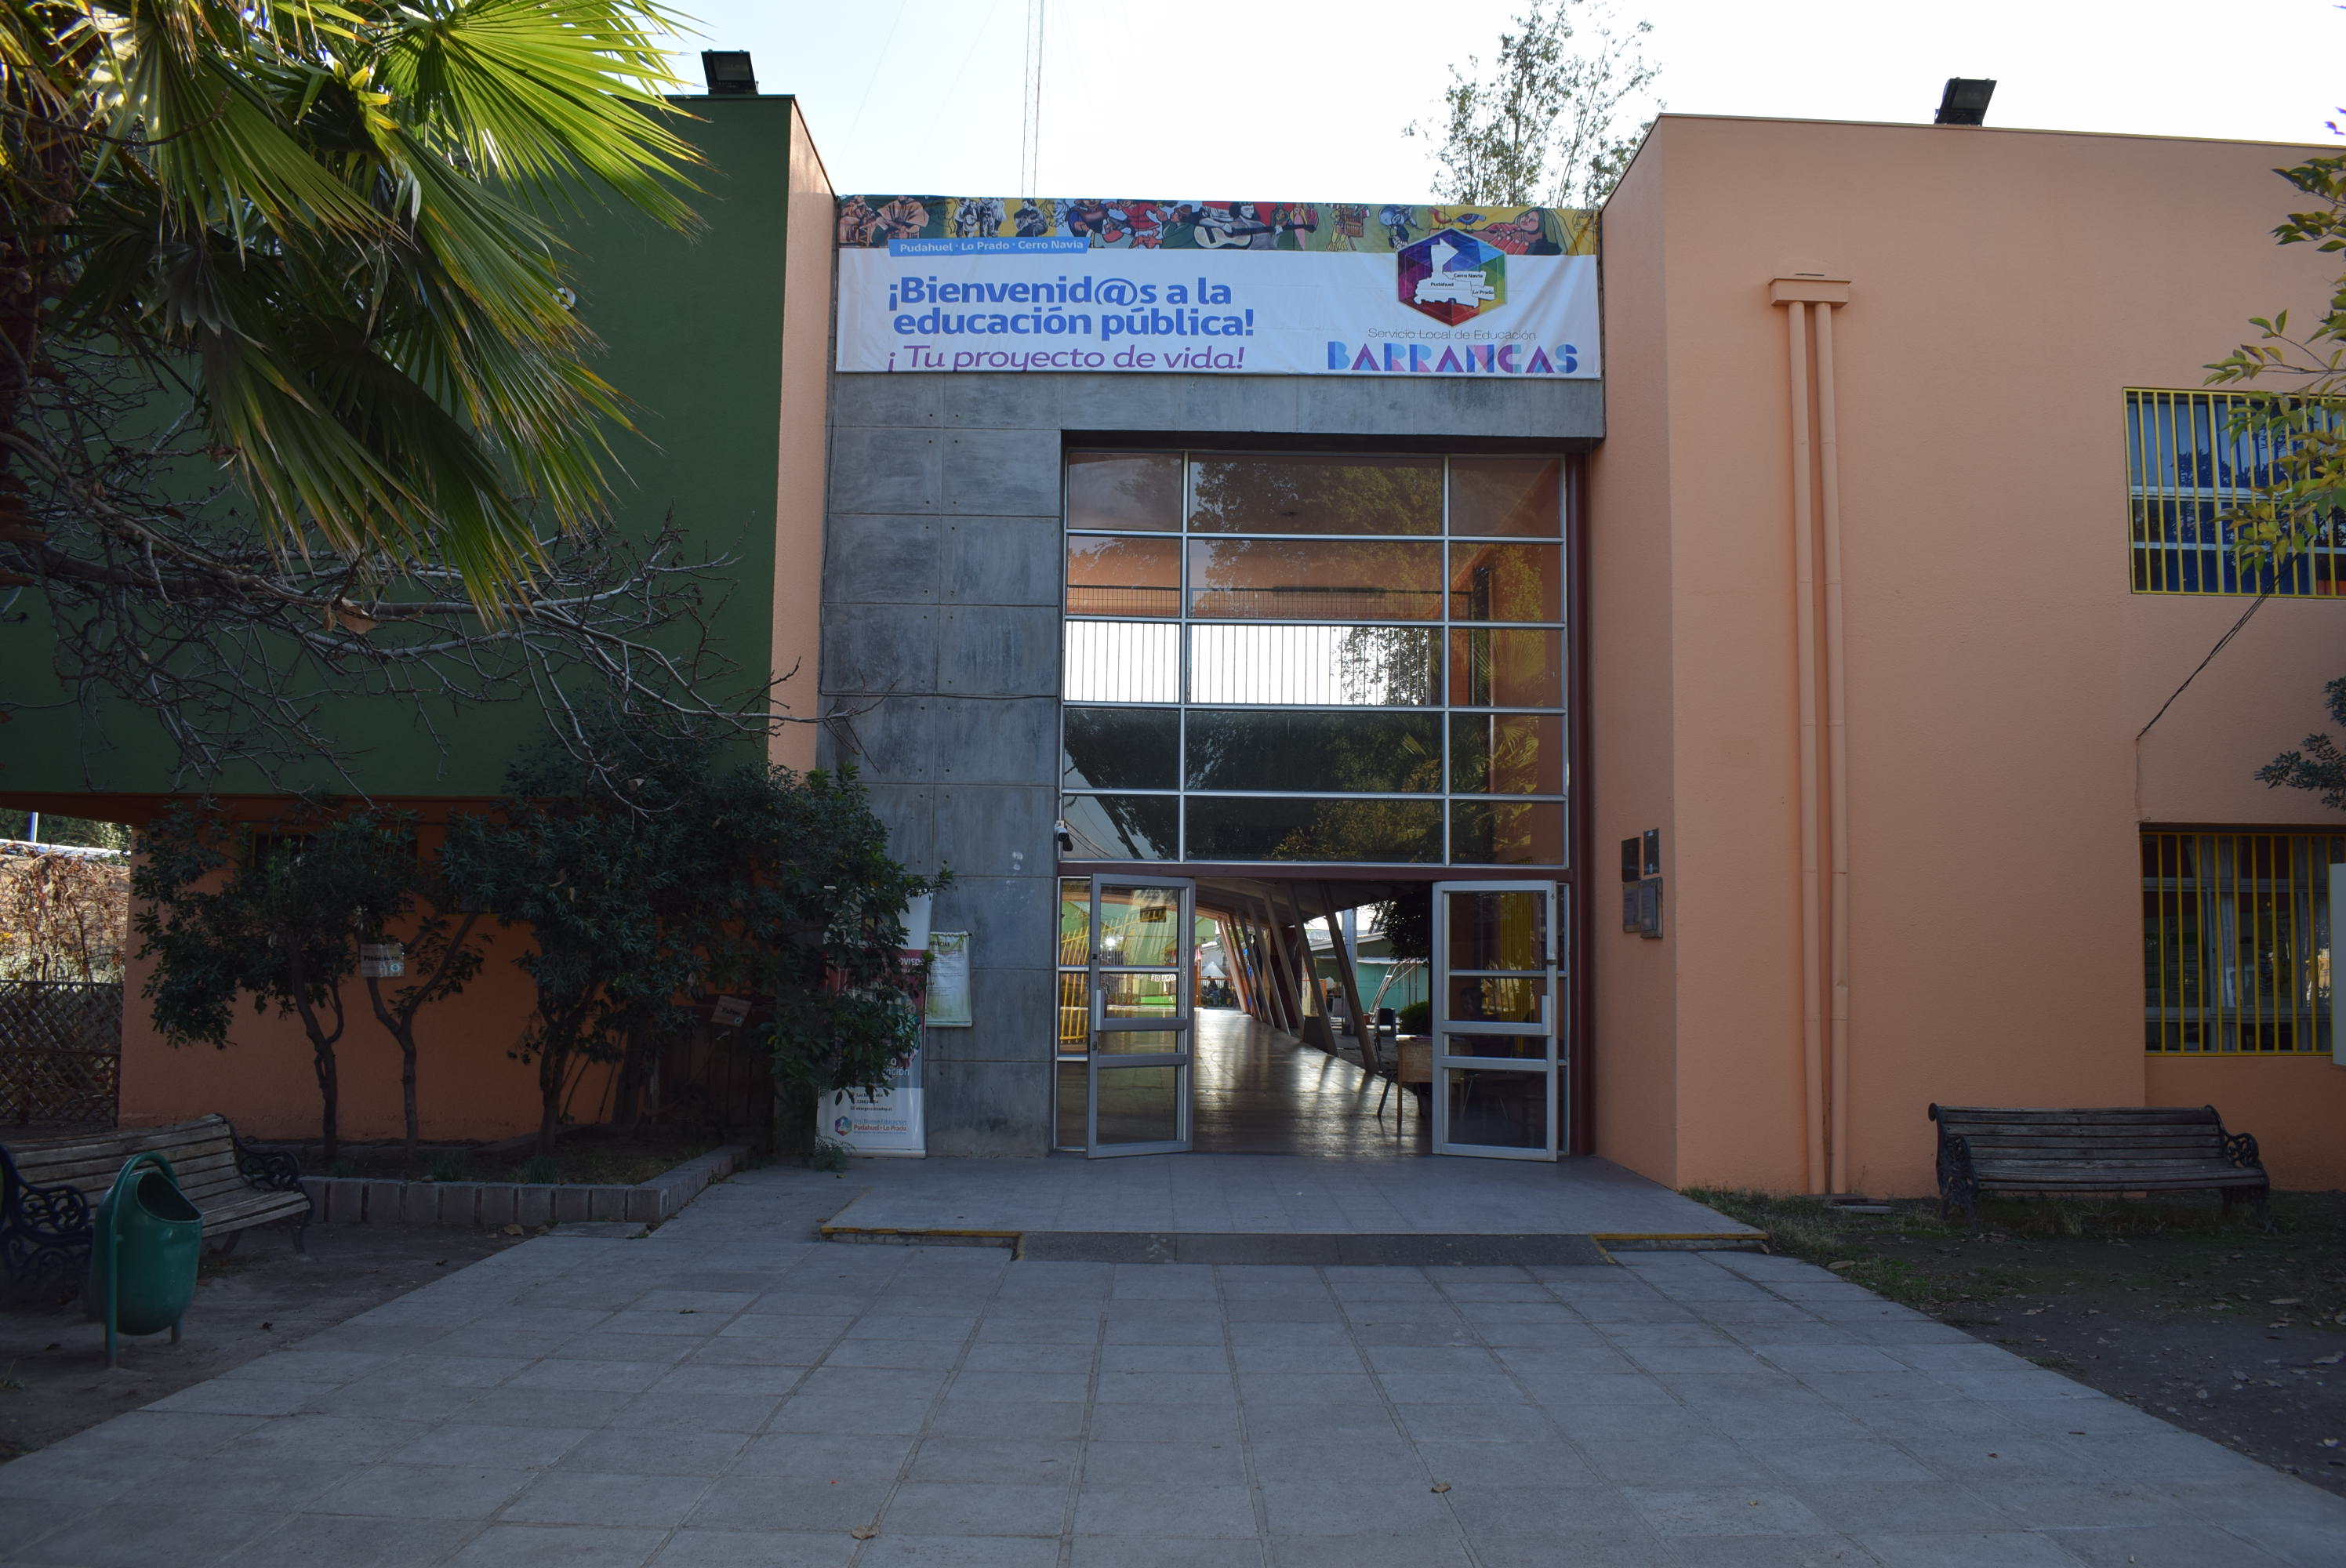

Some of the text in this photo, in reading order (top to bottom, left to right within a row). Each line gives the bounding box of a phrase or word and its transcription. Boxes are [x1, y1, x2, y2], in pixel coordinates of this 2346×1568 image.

[899, 239, 1084, 252] Pudahuel Lo Prado Cerro Navia
[888, 275, 1232, 311] ¡Bienvenid@s a la
[893, 305, 1254, 342] educación pública!
[1367, 328, 1537, 341] Servicio Local de Educación
[953, 347, 1105, 373] proyecto
[1113, 344, 1156, 368] de
[1163, 345, 1245, 370] vida!
[1327, 340, 1578, 375] BARRANCAS
